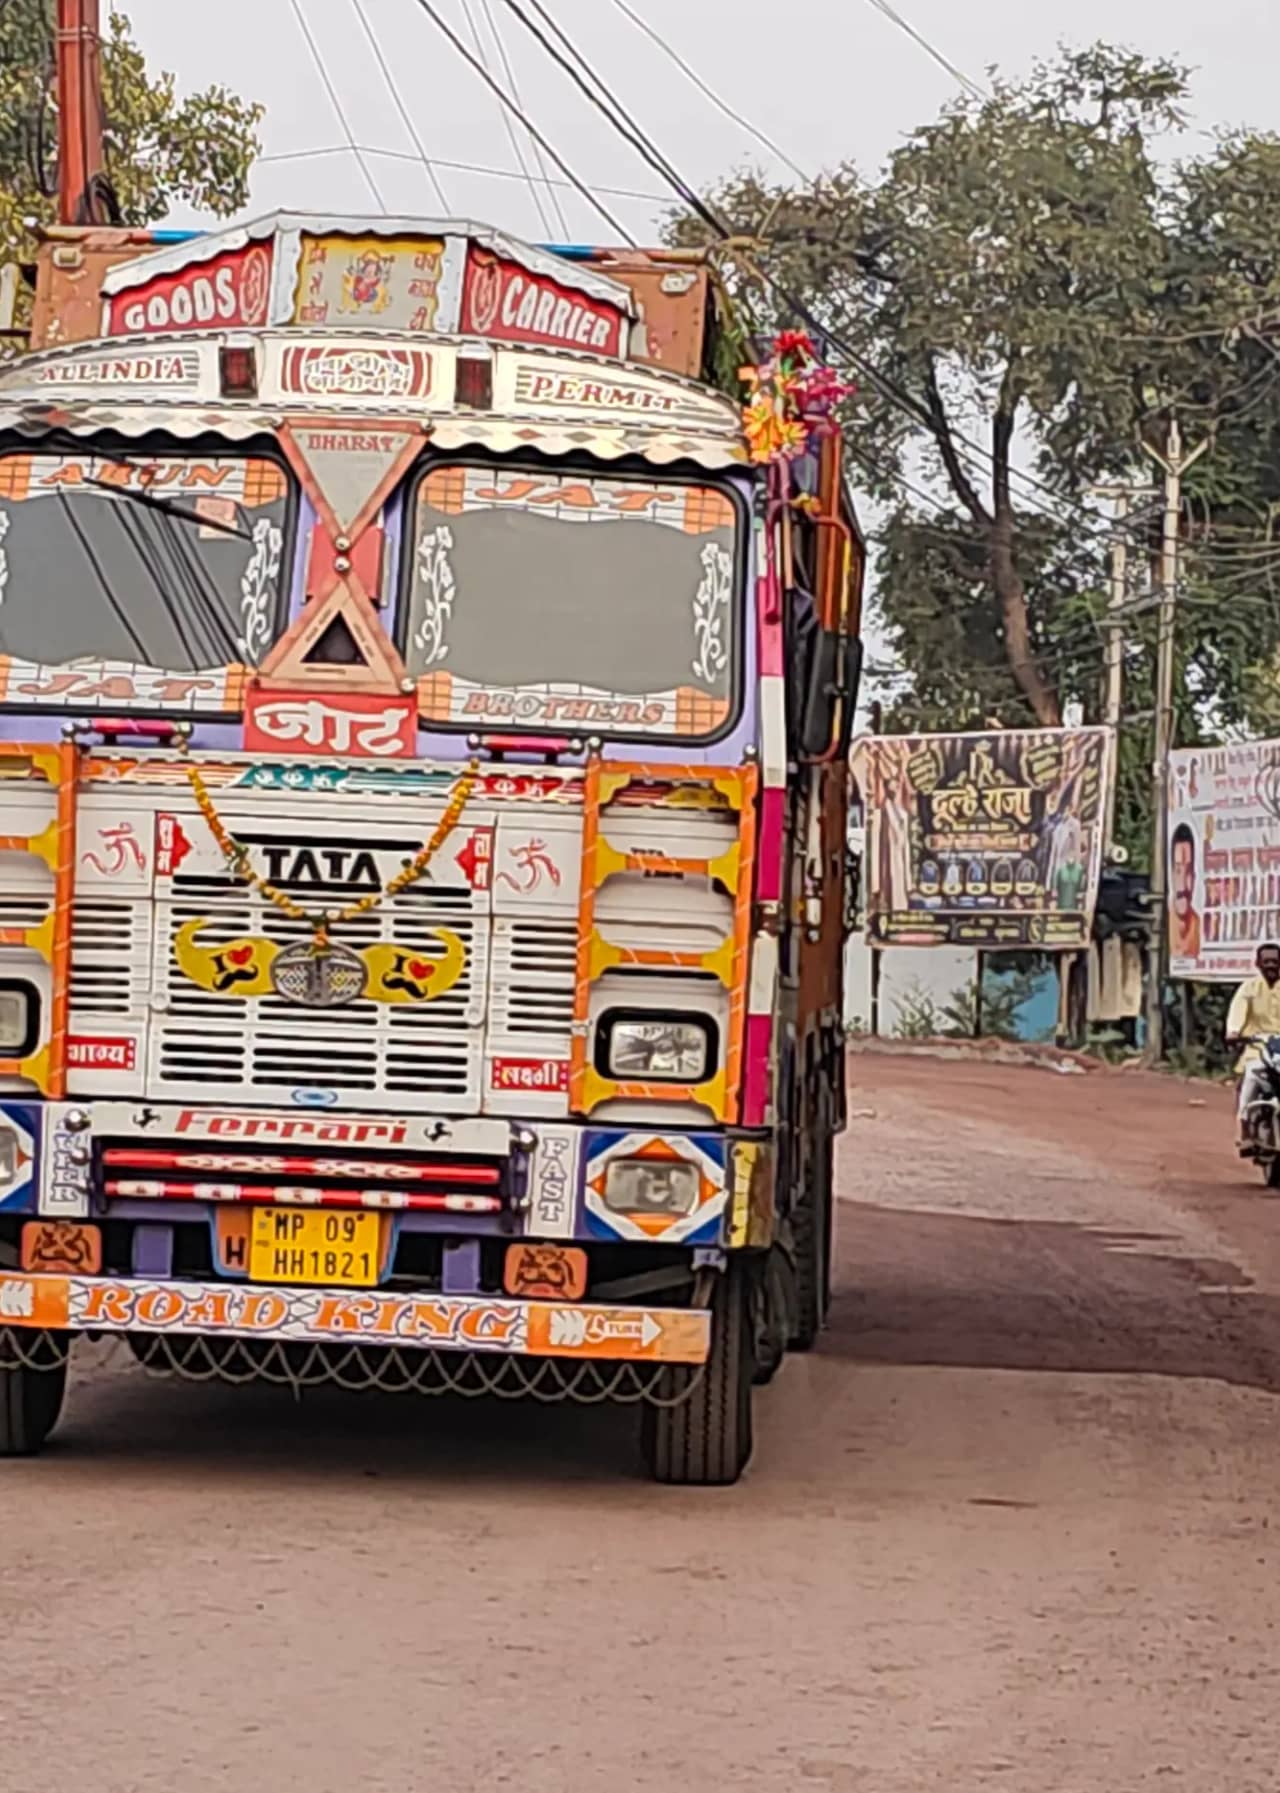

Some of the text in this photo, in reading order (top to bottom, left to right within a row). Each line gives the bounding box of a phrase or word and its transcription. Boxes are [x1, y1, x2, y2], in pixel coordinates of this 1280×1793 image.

[124, 267, 236, 330] GOODS
[501, 275, 611, 347] CARRIER
[39, 357, 186, 382] ALL INDIA
[531, 375, 680, 410] PERMIT
[308, 434, 394, 452] BHARAT
[40, 462, 235, 487] ARUN
[474, 480, 676, 511] JAT
[18, 674, 215, 701] JAT
[461, 692, 667, 725] BROTHERS
[254, 700, 410, 755] जाट
[982, 787, 1033, 825] राजा
[262, 847, 382, 882] TATA
[175, 1109, 408, 1144] Ferrari
[538, 1137, 570, 1222] FAST
[275, 1213, 356, 1242] MP 09
[273, 1248, 370, 1278] HH1821
[80, 1284, 521, 1344] ROAD KING
